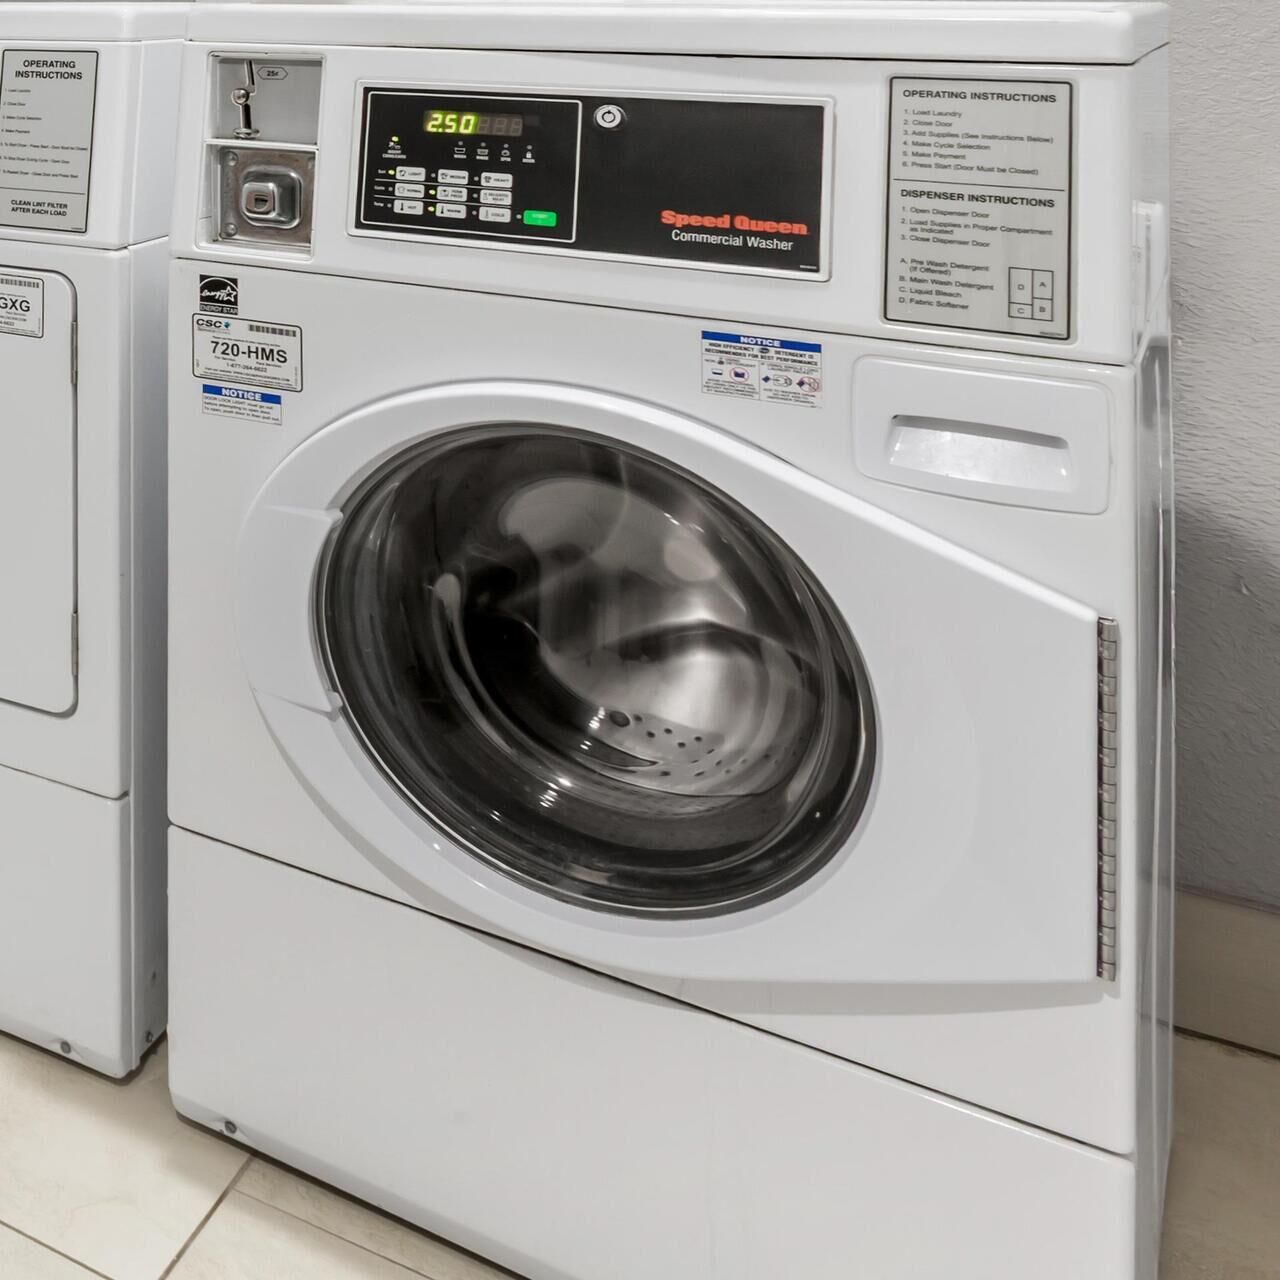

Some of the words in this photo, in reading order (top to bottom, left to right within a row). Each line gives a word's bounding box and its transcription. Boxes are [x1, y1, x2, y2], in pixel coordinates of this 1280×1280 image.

[22, 59, 76, 69] OPERATING
[15, 70, 83, 80] INSTRUCTIONS
[903, 89, 967, 99] OPERATING
[970, 91, 1056, 102] INSTRUCTIONS
[426, 112, 476, 134] 2.50
[900, 189, 964, 201] DISPENSER
[967, 193, 1054, 207] INSTRUCTIONS
[661, 210, 730, 228] Speed
[734, 215, 808, 235] Queen
[672, 230, 743, 246] Commercial
[747, 236, 794, 251] Washer
[196, 318, 222, 328] CSC
[740, 336, 781, 347] NOTICE
[210, 341, 287, 363] 720-HMS
[222, 388, 261, 401] NOTICE
